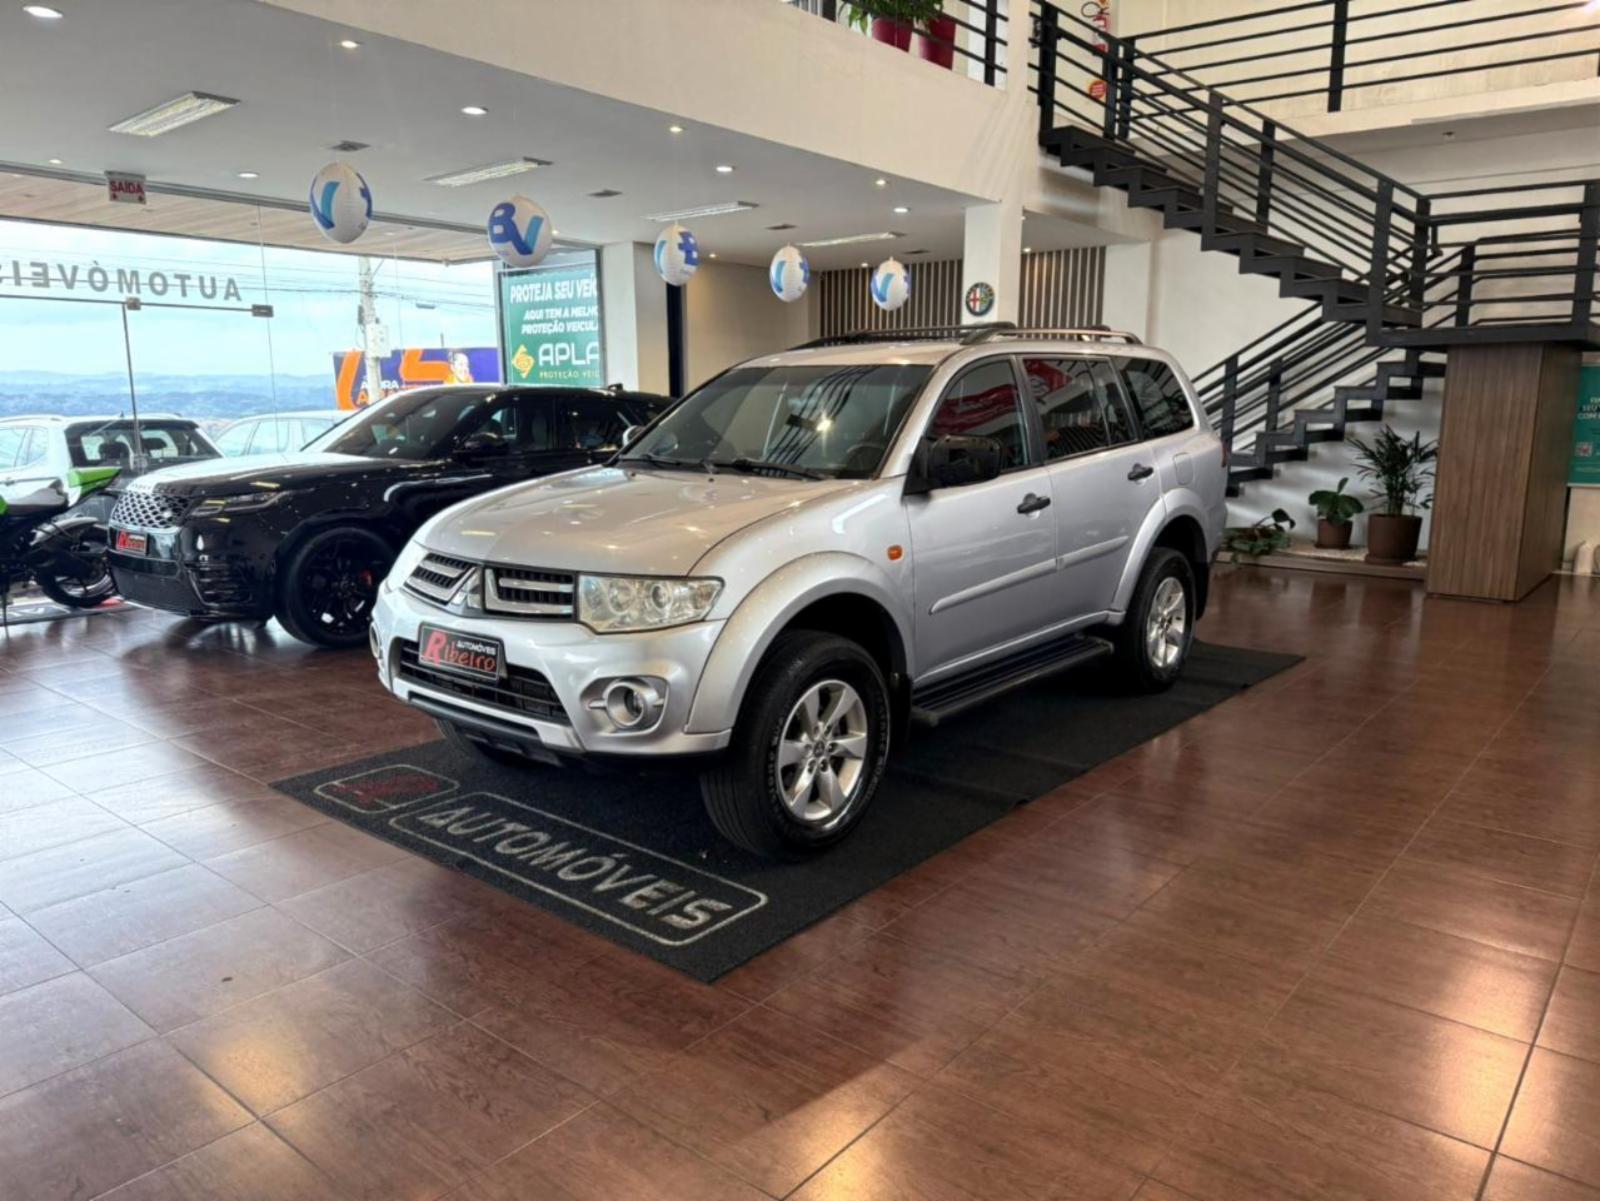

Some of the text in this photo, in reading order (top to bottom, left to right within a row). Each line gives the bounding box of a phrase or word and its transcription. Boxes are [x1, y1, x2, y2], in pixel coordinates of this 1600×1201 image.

[510, 282, 553, 304] PROTEJA
[554, 279, 576, 301] SEU
[523, 310, 544, 321] AQUI
[545, 308, 562, 319] TEM
[563, 308, 570, 318] A
[521, 320, 564, 335] PROTEÇÃO
[416, 806, 734, 930] AUTOMÓVEIS
